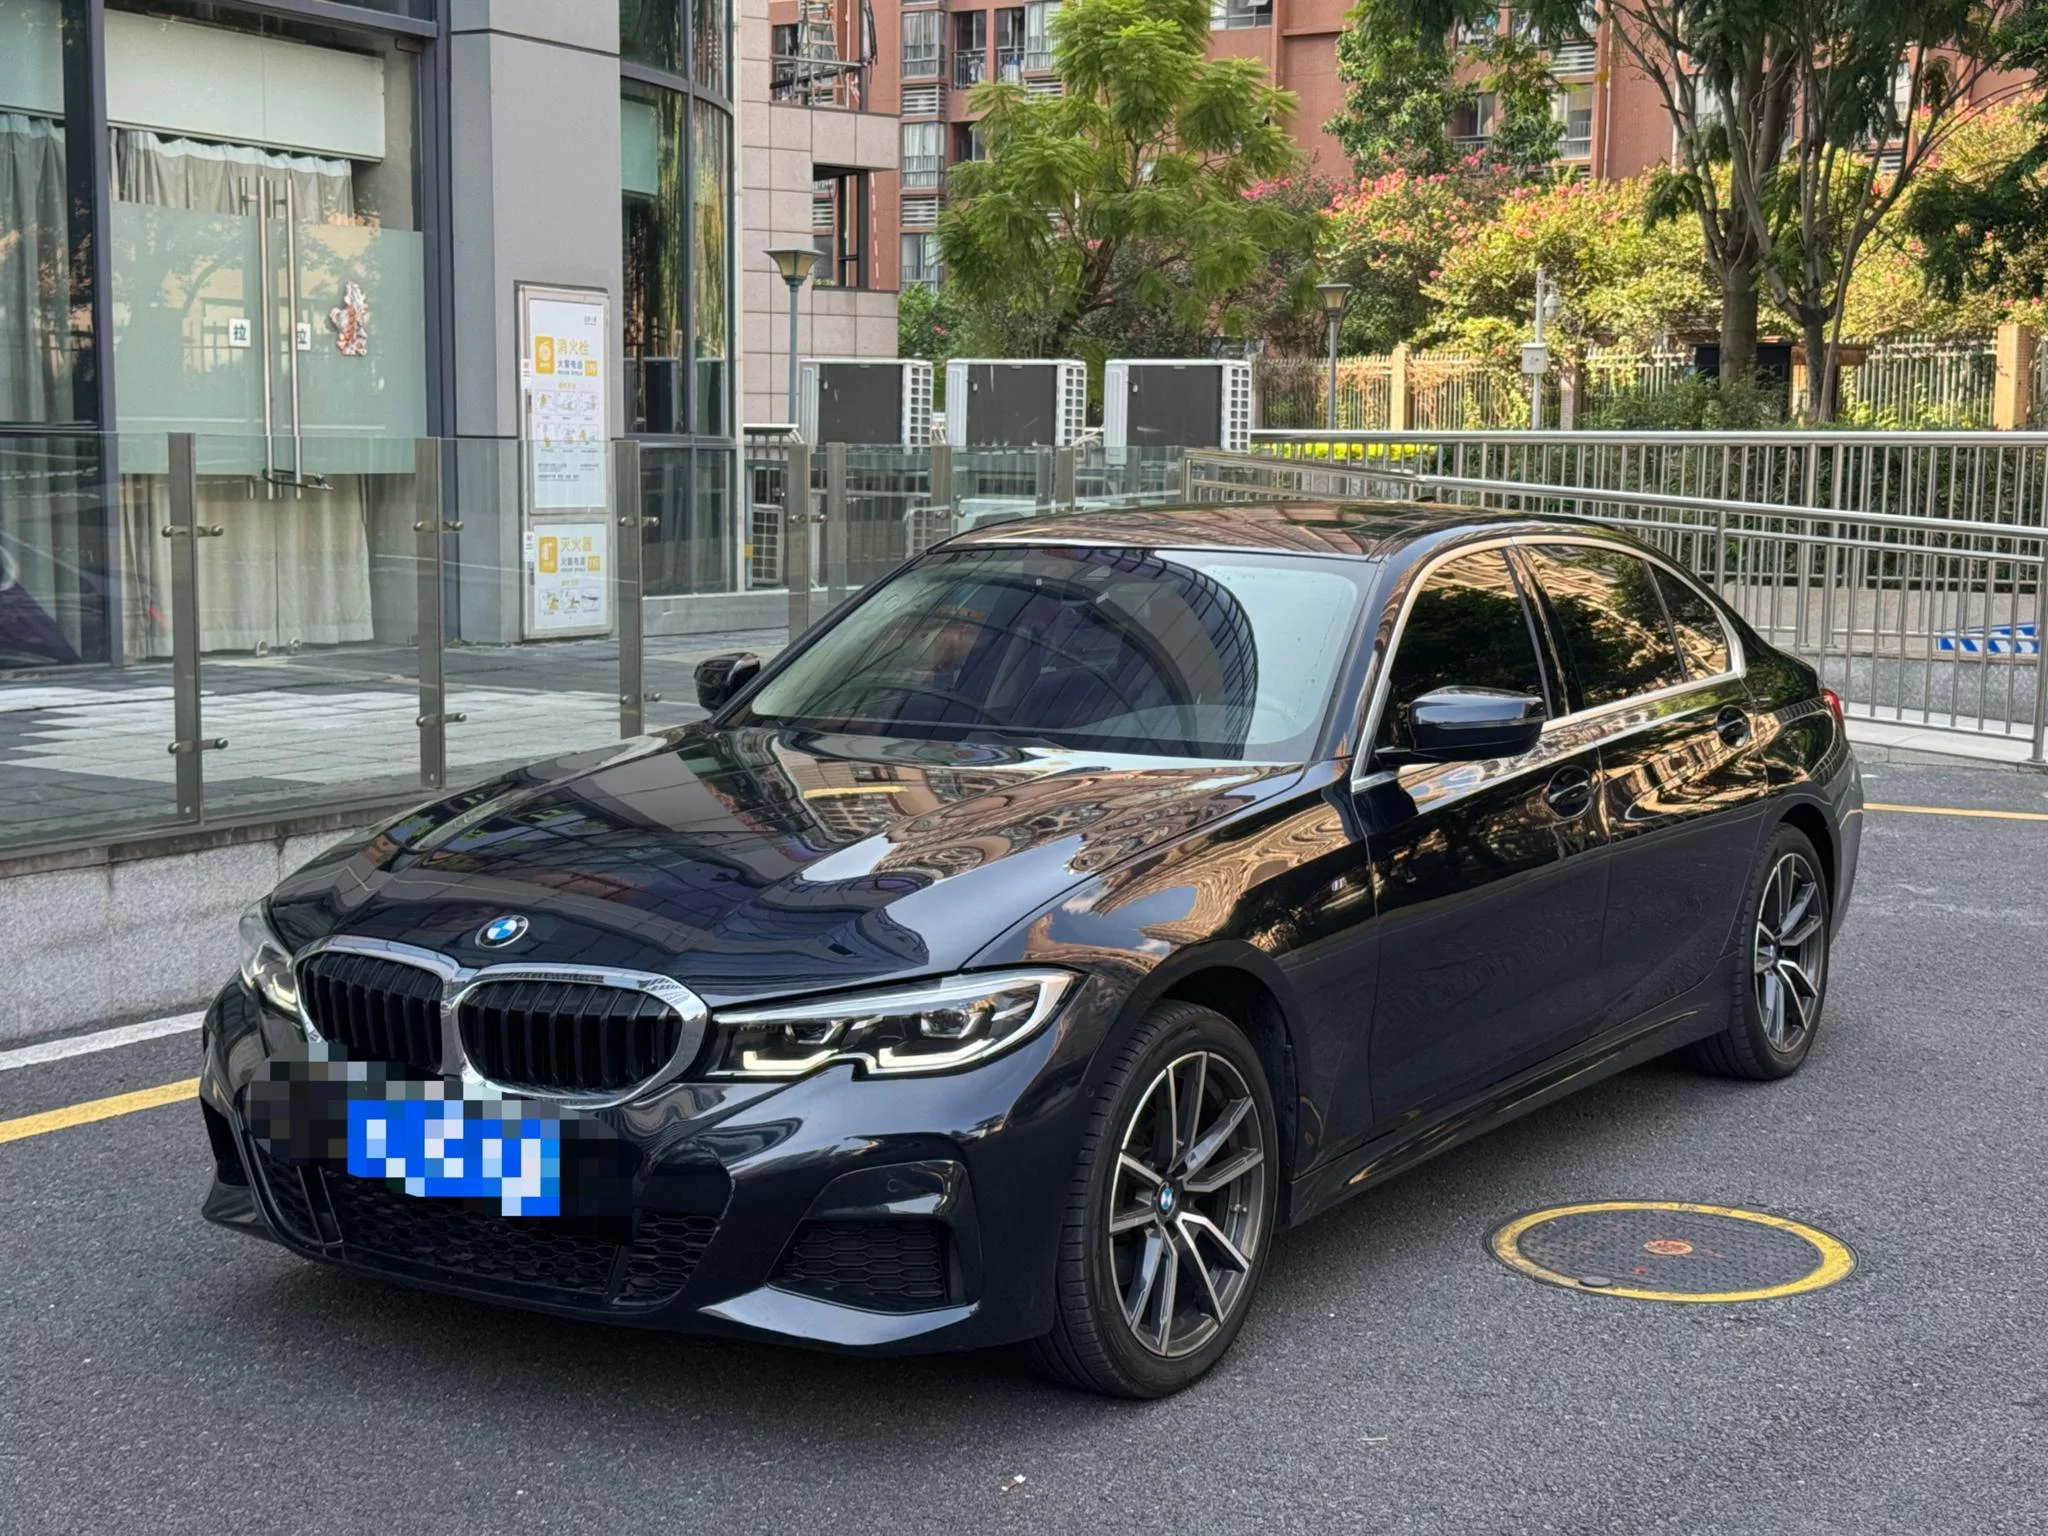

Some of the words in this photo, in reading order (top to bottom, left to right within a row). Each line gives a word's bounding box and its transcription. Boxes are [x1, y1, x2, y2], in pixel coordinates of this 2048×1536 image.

[233, 323, 247, 341] 拉
[557, 338, 590, 356] 消火栓
[560, 536, 593, 552] 灭火器
